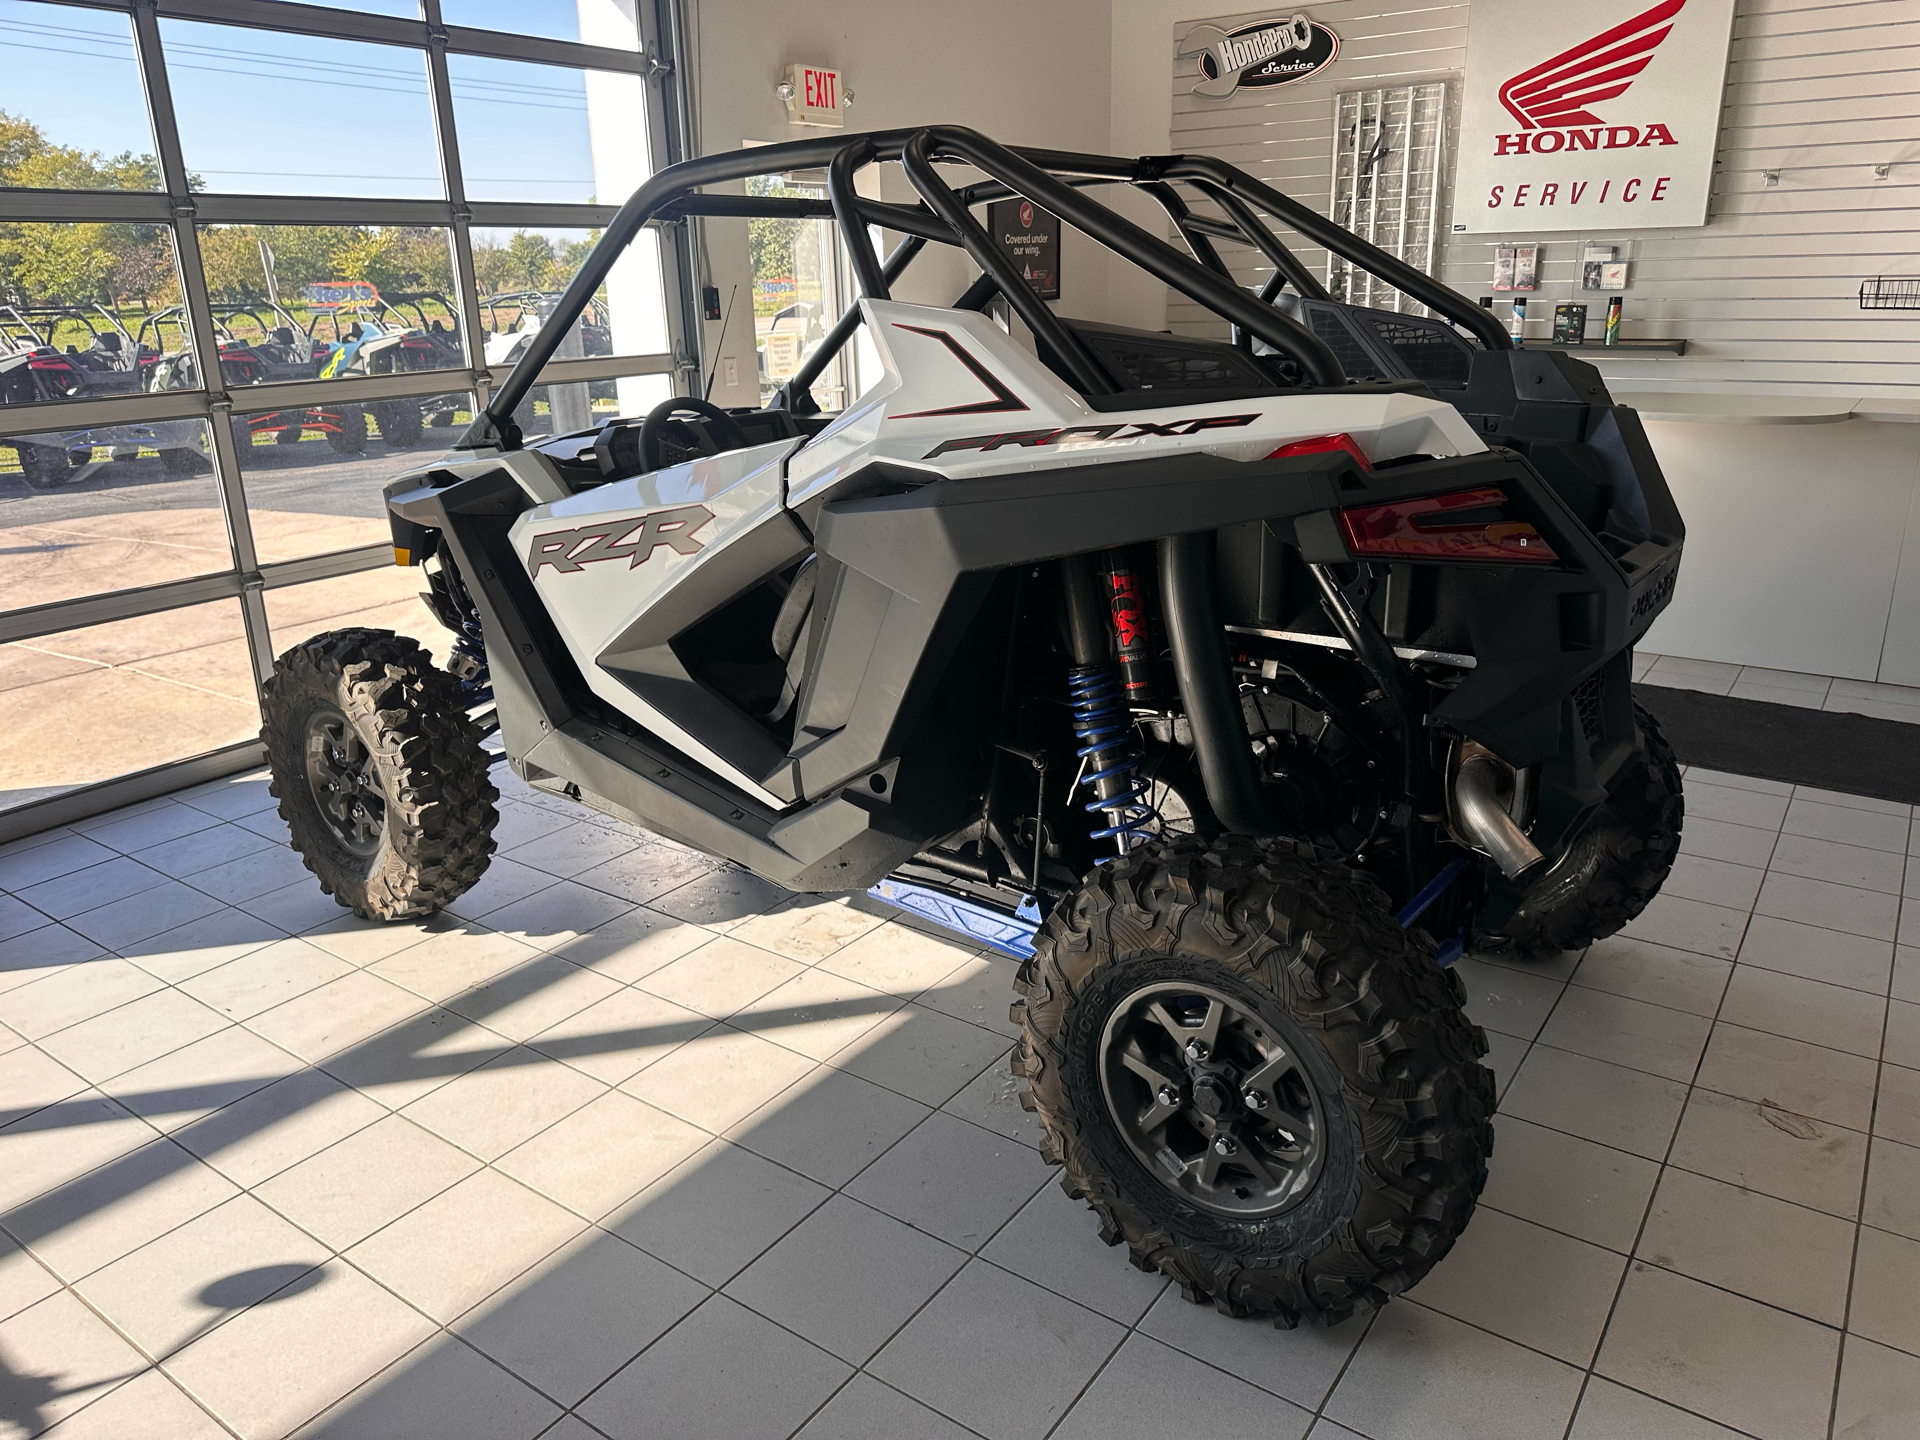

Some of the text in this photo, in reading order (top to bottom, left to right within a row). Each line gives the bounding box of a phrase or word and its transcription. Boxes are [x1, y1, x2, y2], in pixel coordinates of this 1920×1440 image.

[1217, 28, 1294, 74] HondaPro
[1261, 59, 1315, 74] Service
[804, 69, 836, 109] EXIT
[1493, 123, 1679, 156] HONDA
[1487, 177, 1671, 208] SERVICE
[1005, 234, 1048, 245] Covered under
[1013, 245, 1040, 256] our wing.
[337, 297, 376, 314] Sports
[527, 504, 717, 581] RZR
